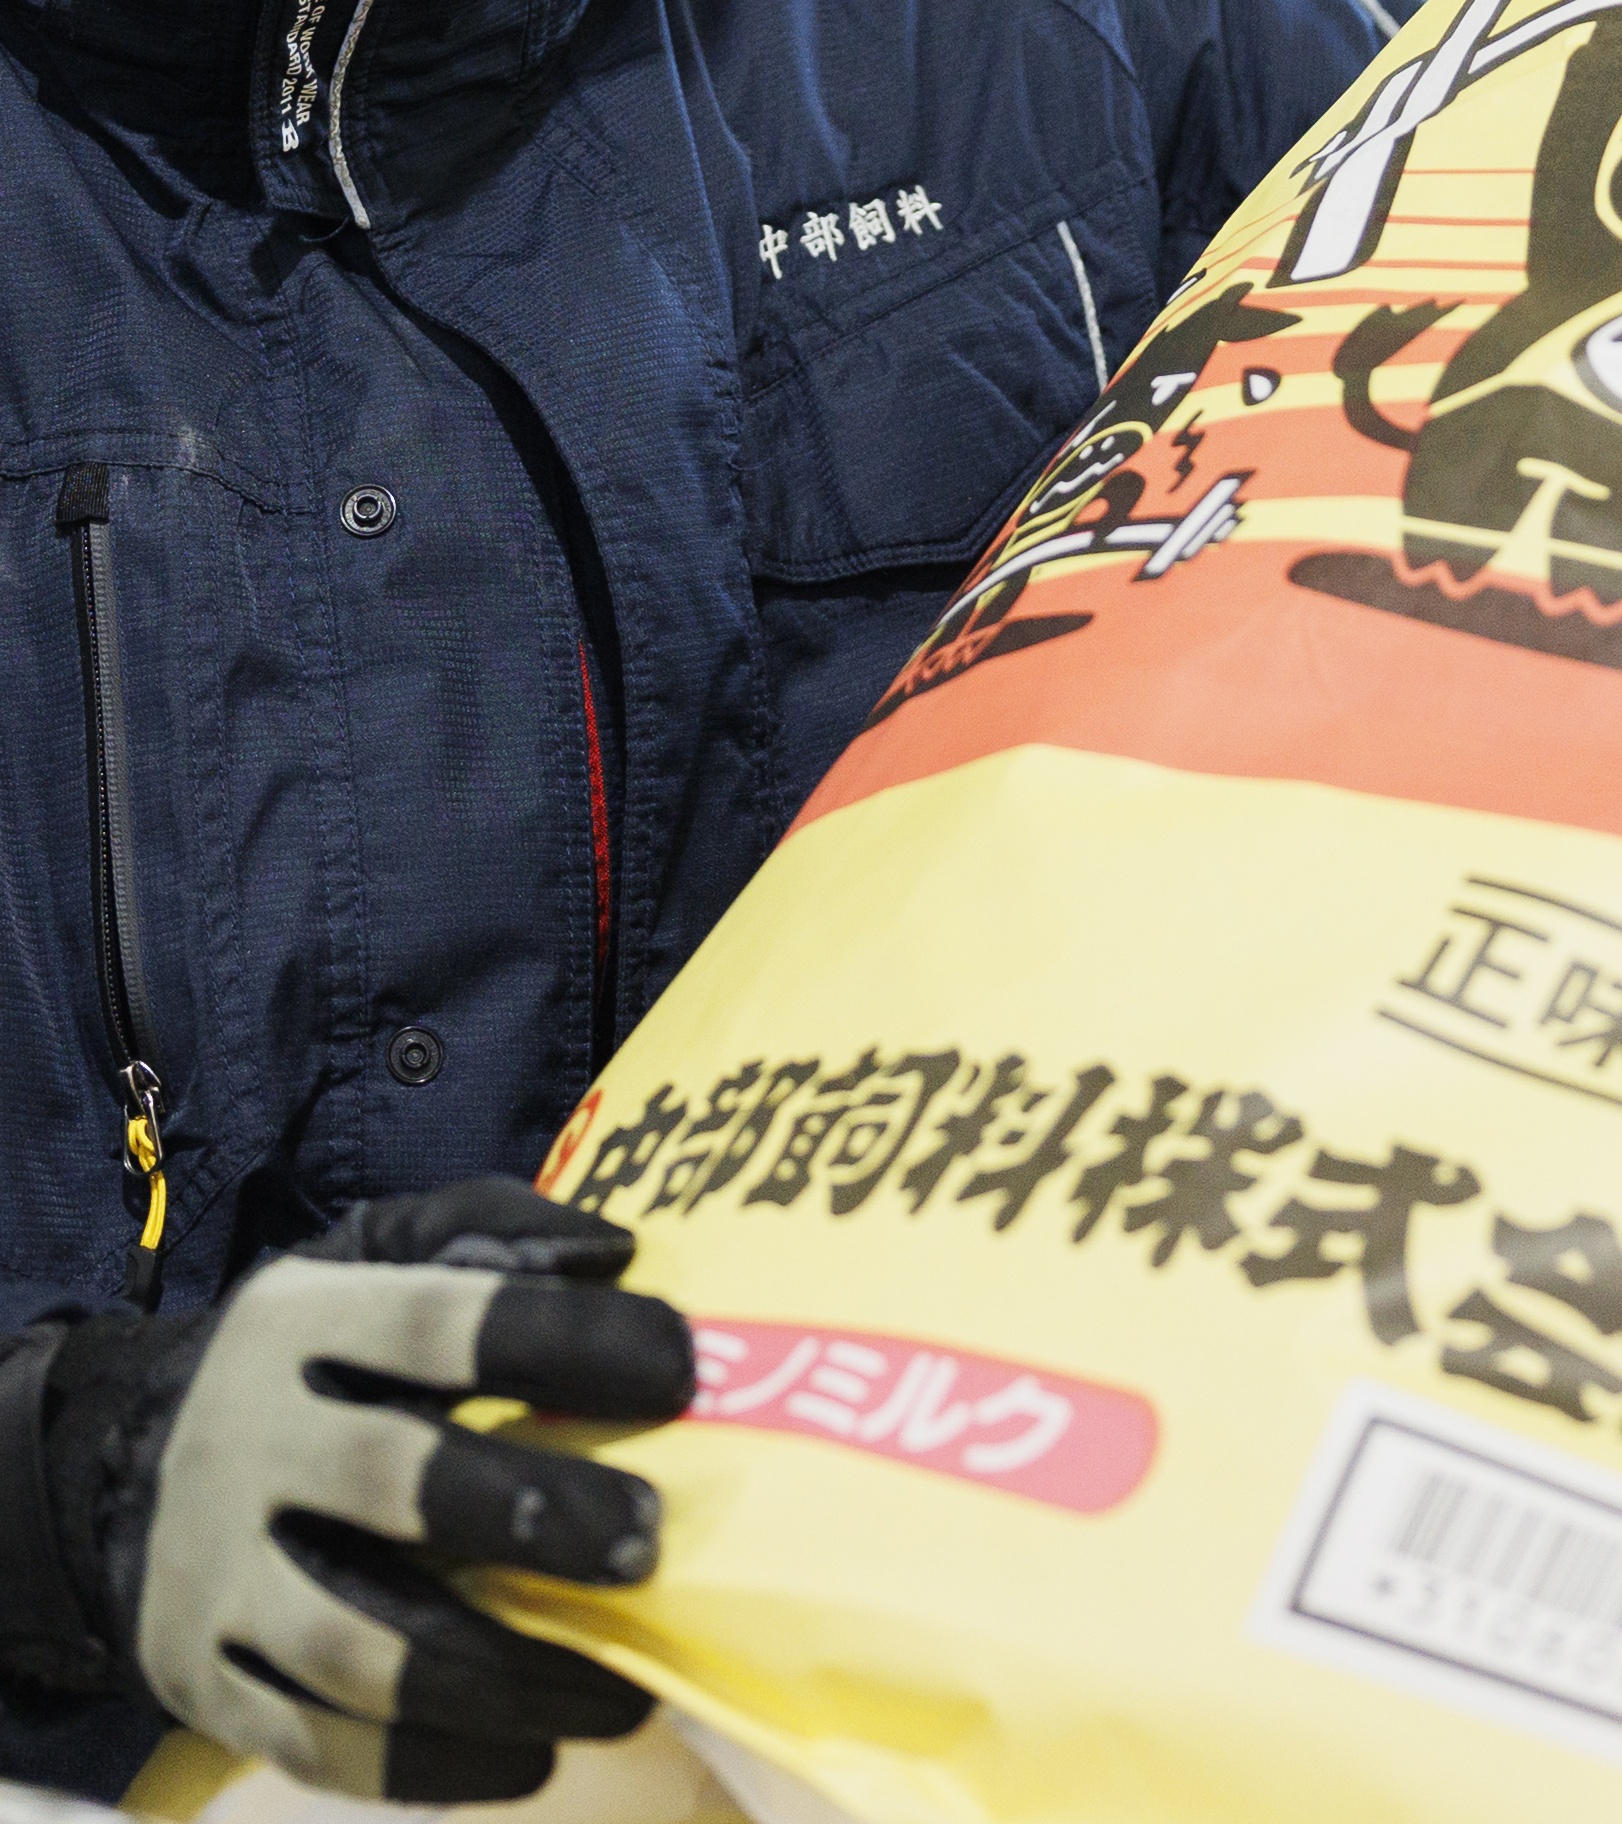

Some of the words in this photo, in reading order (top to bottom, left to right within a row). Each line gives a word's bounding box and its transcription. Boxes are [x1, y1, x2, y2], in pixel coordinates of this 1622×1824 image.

[308, 5, 326, 24] OF
[279, 77, 298, 115] 2011
[295, 78, 319, 127] WEAR
[759, 184, 944, 280] 中部飼料
